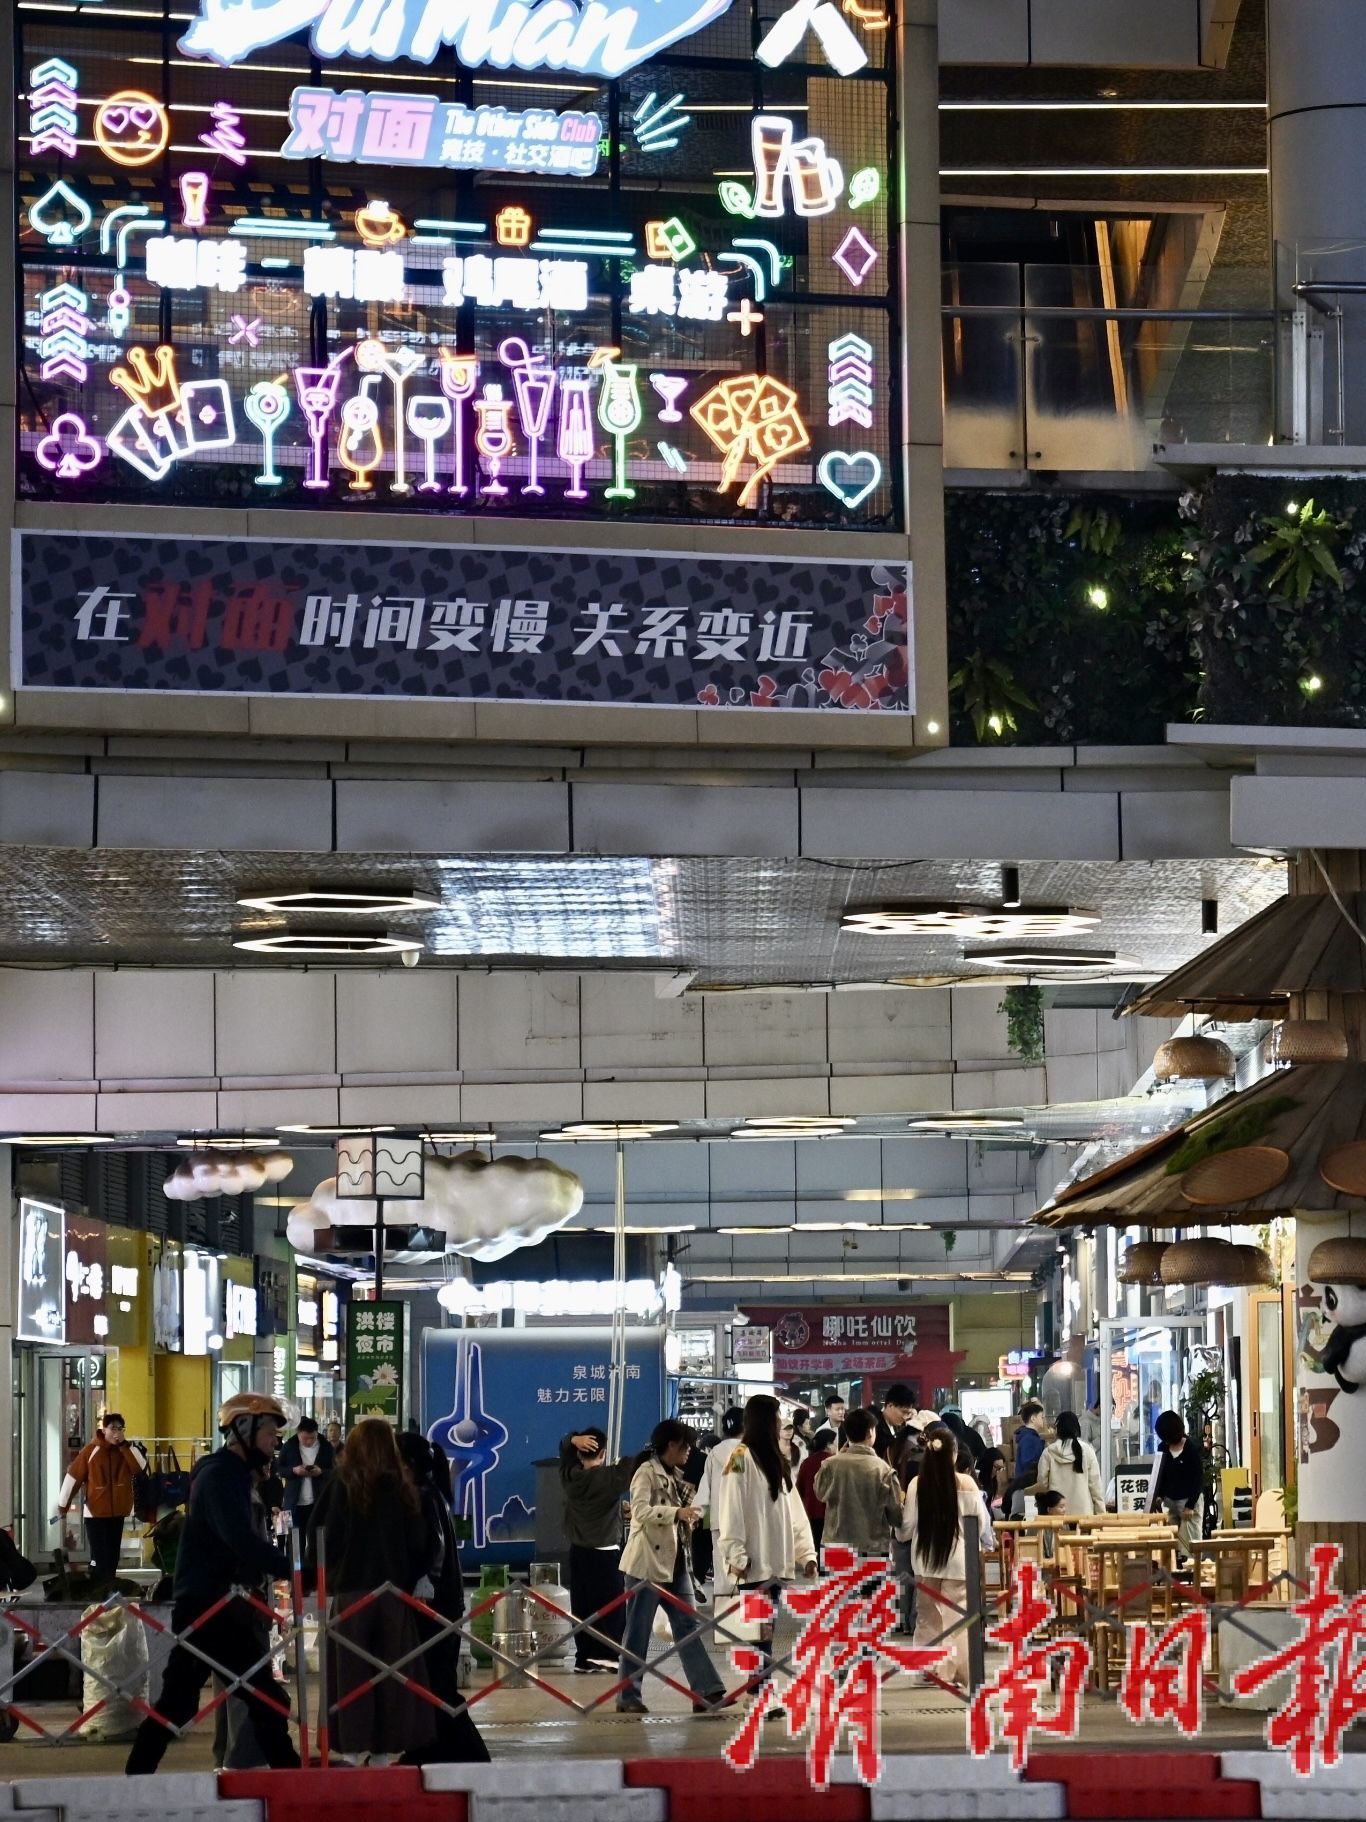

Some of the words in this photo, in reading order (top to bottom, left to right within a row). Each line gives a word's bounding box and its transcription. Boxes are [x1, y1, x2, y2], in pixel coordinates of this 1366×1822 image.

[293, 93, 436, 161] 对面
[445, 110, 475, 135] The
[561, 118, 597, 143] Club
[73, 580, 549, 655] 在对面时间变慢
[571, 603, 813, 664] 关系变近
[356, 1311, 395, 1331] 洪楼
[356, 1335, 394, 1353] 夜市
[537, 1387, 605, 1403] 魅力无限
